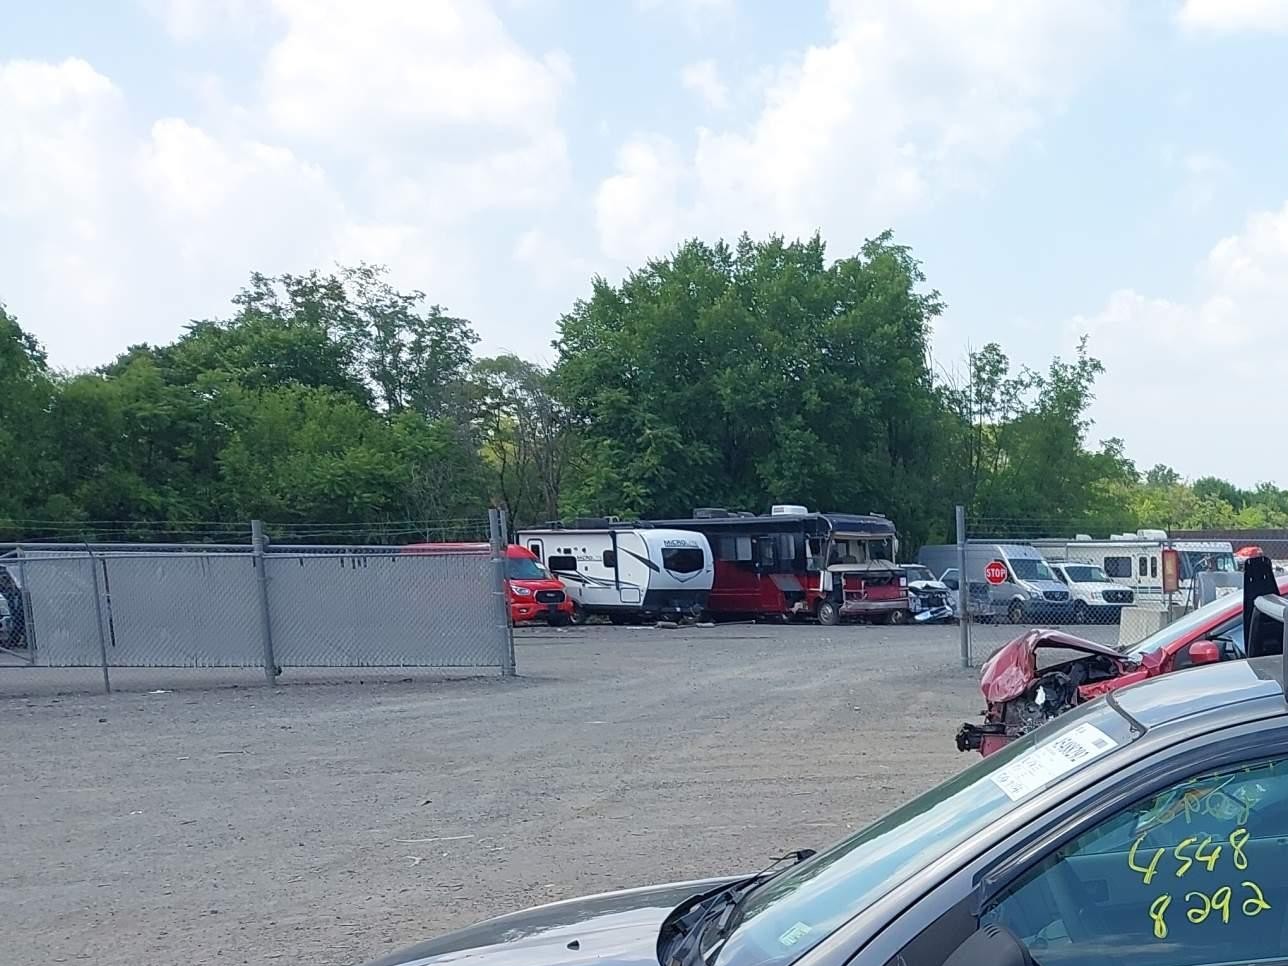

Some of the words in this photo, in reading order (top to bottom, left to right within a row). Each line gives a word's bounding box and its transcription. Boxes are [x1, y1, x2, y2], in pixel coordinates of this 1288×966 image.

[986, 568, 1006, 578] STOP
[1128, 829, 1250, 885] 4548
[1149, 881, 1272, 939] 8292
